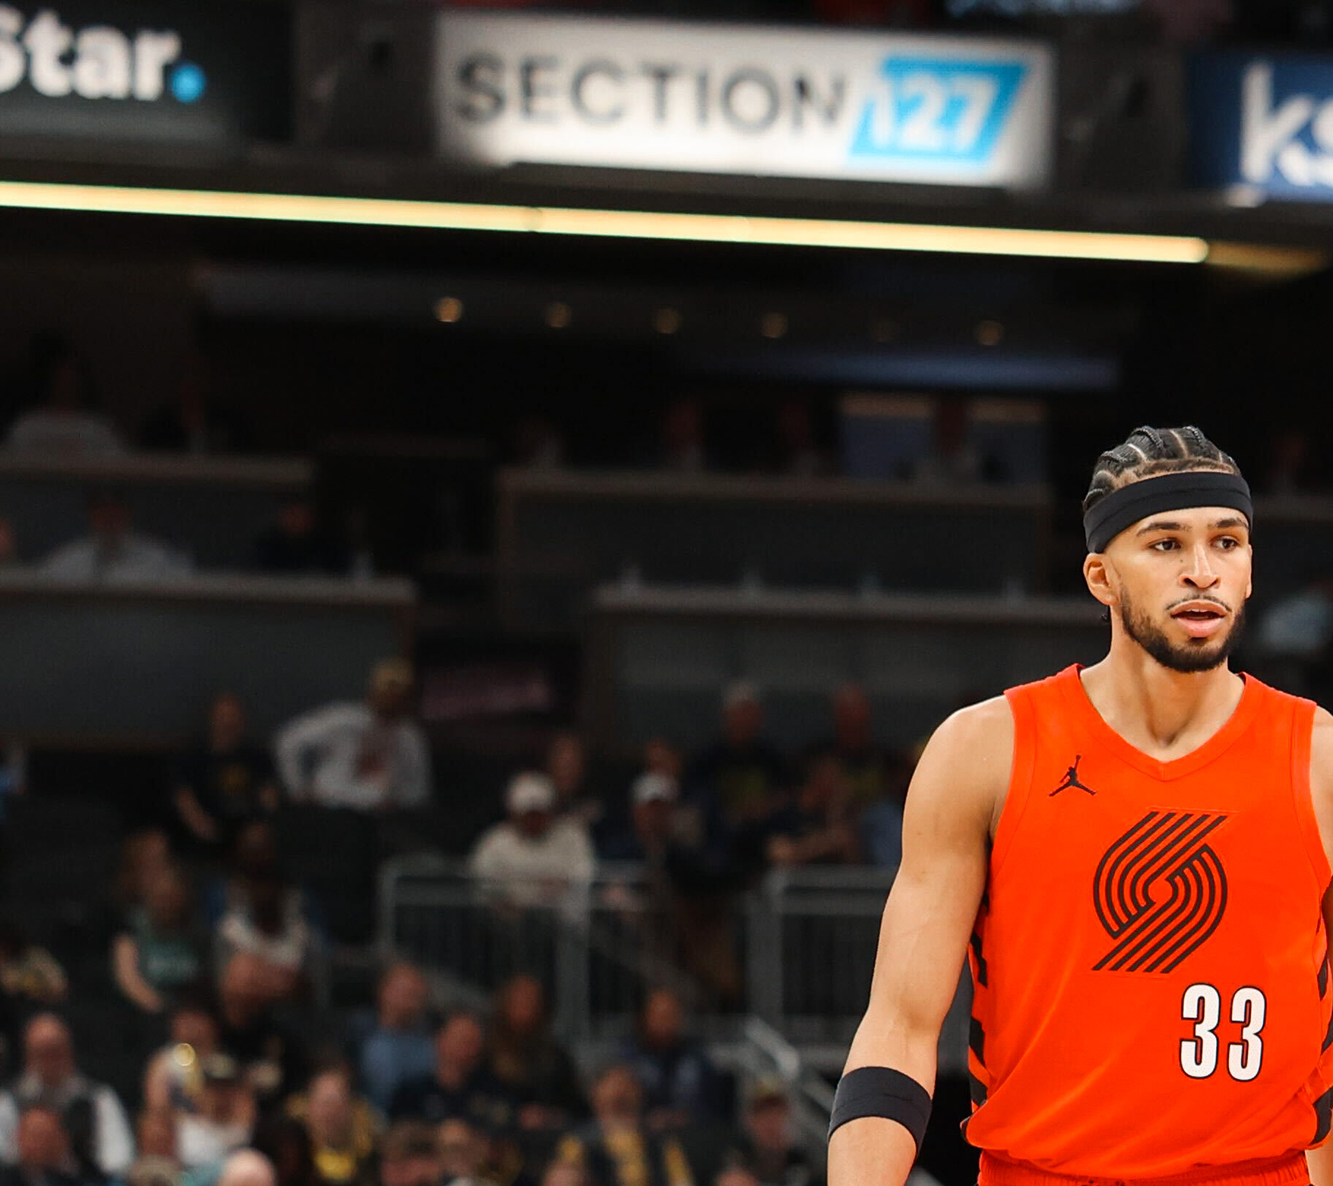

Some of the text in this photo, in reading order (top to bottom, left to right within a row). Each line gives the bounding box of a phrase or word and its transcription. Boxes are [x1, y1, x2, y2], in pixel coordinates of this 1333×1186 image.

[456, 52, 1001, 153] SECTION 127
[1179, 982, 1267, 1082] 33
